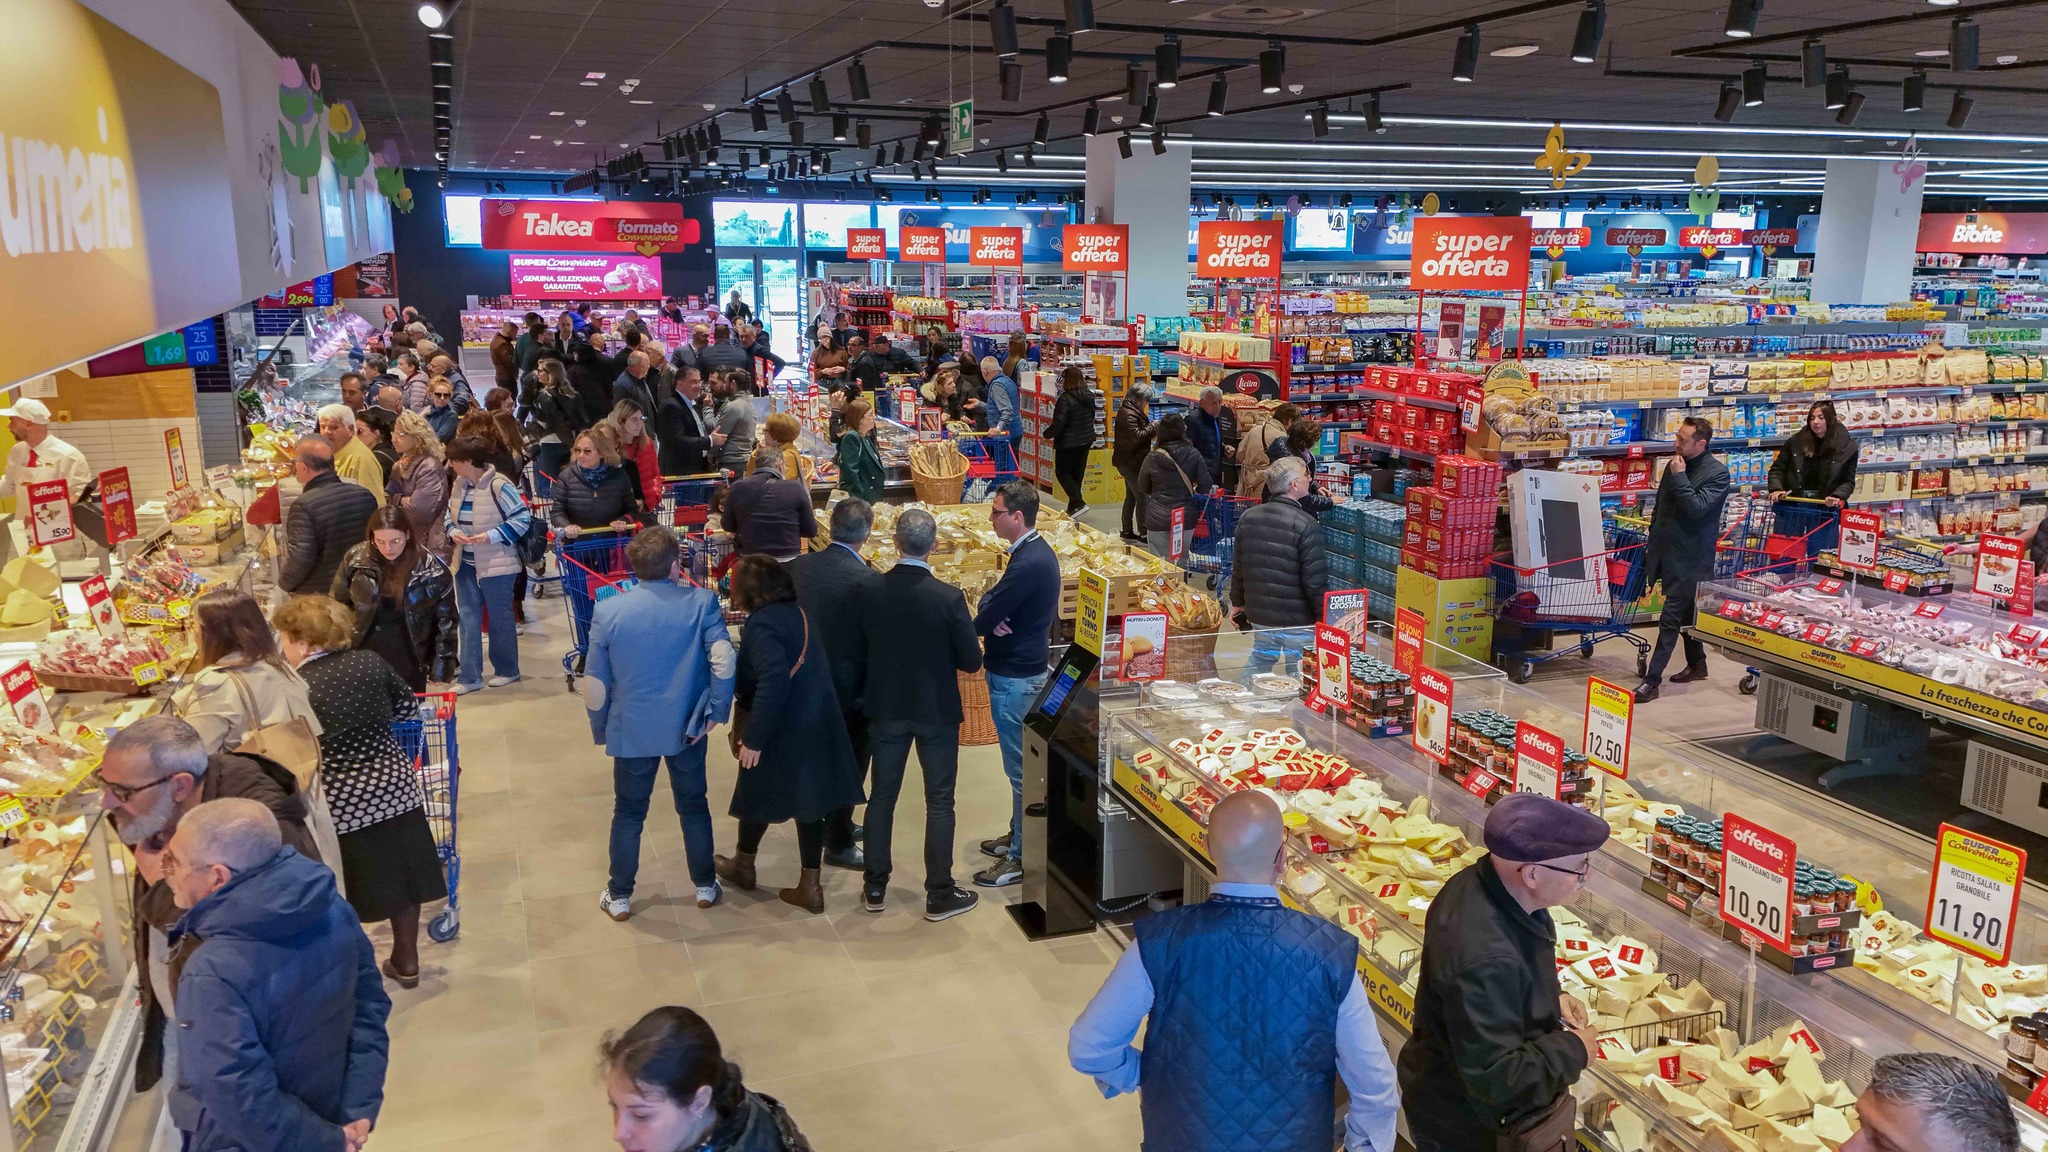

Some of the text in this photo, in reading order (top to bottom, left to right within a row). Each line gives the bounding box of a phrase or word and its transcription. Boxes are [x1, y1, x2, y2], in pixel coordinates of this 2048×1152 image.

[617, 219, 678, 234] formato
[1952, 224, 2003, 243] Bibite
[617, 232, 678, 242] Conveniente
[855, 234, 880, 245] super
[910, 234, 940, 246] super
[981, 235, 1016, 249] super
[1078, 234, 1121, 251] super
[1217, 234, 1272, 252] super
[1534, 229, 1580, 246] offerta
[1616, 230, 1657, 244] offerta
[1689, 229, 1733, 245] offerta
[1751, 229, 1791, 244] offerta
[851, 242, 881, 253] offerta
[905, 243, 940, 256] offerta
[975, 245, 1016, 260] offerta
[1435, 234, 1514, 258] super
[1070, 246, 1120, 263] offerta
[1207, 247, 1271, 268] offerta
[1421, 252, 1510, 277] offerta
[1443, 305, 1463, 315] offerta
[193, 331, 207, 343] 25
[154, 345, 182, 363] 1,69
[196, 350, 210, 362] 00
[1238, 377, 1259, 390] Licitra
[34, 485, 63, 497] offerta
[110, 480, 128, 493] SONO
[1846, 514, 1874, 526] offerta
[1986, 539, 2018, 552] offerta
[85, 581, 105, 598] offerta
[1329, 600, 1364, 610] CROSTATE
[1330, 595, 1351, 604] TORTE
[1084, 605, 1096, 619] TUO
[1081, 617, 1098, 632] TURNO
[1405, 624, 1422, 639] SONO
[1733, 626, 1757, 638] SUPER
[1321, 630, 1345, 647] offerta
[1724, 628, 1765, 646] Conveniente
[1800, 651, 1846, 670] Conveniente
[1811, 649, 1837, 662] SUPER
[7, 670, 31, 692] offerta
[1421, 674, 1447, 694] offerta
[1592, 687, 1627, 705] Conveniente
[1600, 686, 1621, 697] SUPER
[1920, 683, 1934, 698] La
[1935, 689, 2000, 718] freschezza
[2001, 710, 2025, 725] che
[1600, 720, 1613, 730] PEPATO
[1616, 716, 1625, 726] SALE
[1522, 732, 1556, 756] offerta
[1589, 731, 1622, 765] 12,50
[1528, 768, 1546, 783] ORIGINALE
[1133, 784, 1164, 815] Conveniente
[1140, 783, 1158, 802] SUPER
[1733, 828, 1784, 861] offerta
[1962, 837, 2000, 856] SUPER
[1947, 839, 2013, 867] Conveniente
[1731, 854, 1783, 885] GRANA PADANO DOP
[1950, 867, 2001, 893] RICOTTA SALATA
[1956, 881, 1991, 902] GRANOBILE
[1728, 885, 1780, 934] 10,90
[1938, 898, 2002, 947] 11,90
